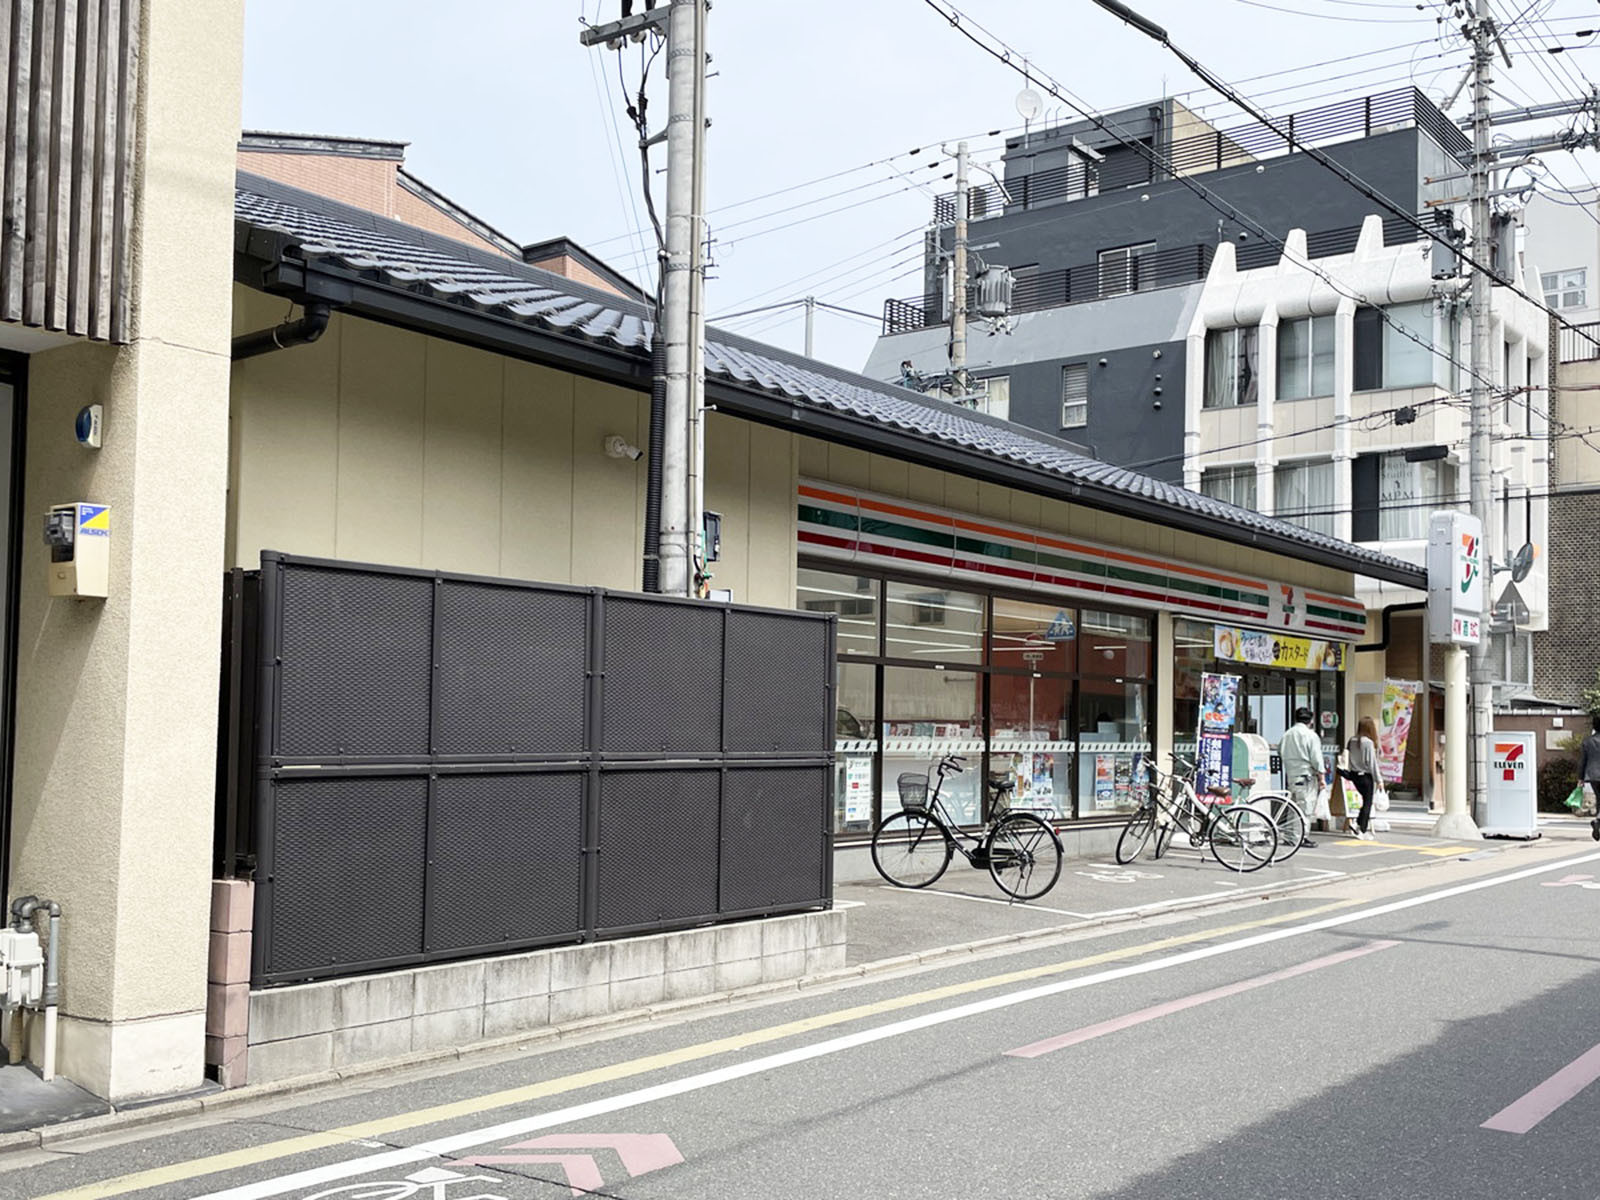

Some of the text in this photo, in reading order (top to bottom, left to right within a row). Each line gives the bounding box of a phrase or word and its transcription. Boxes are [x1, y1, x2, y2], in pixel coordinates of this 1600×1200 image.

[1281, 642, 1309, 662] カスタード
